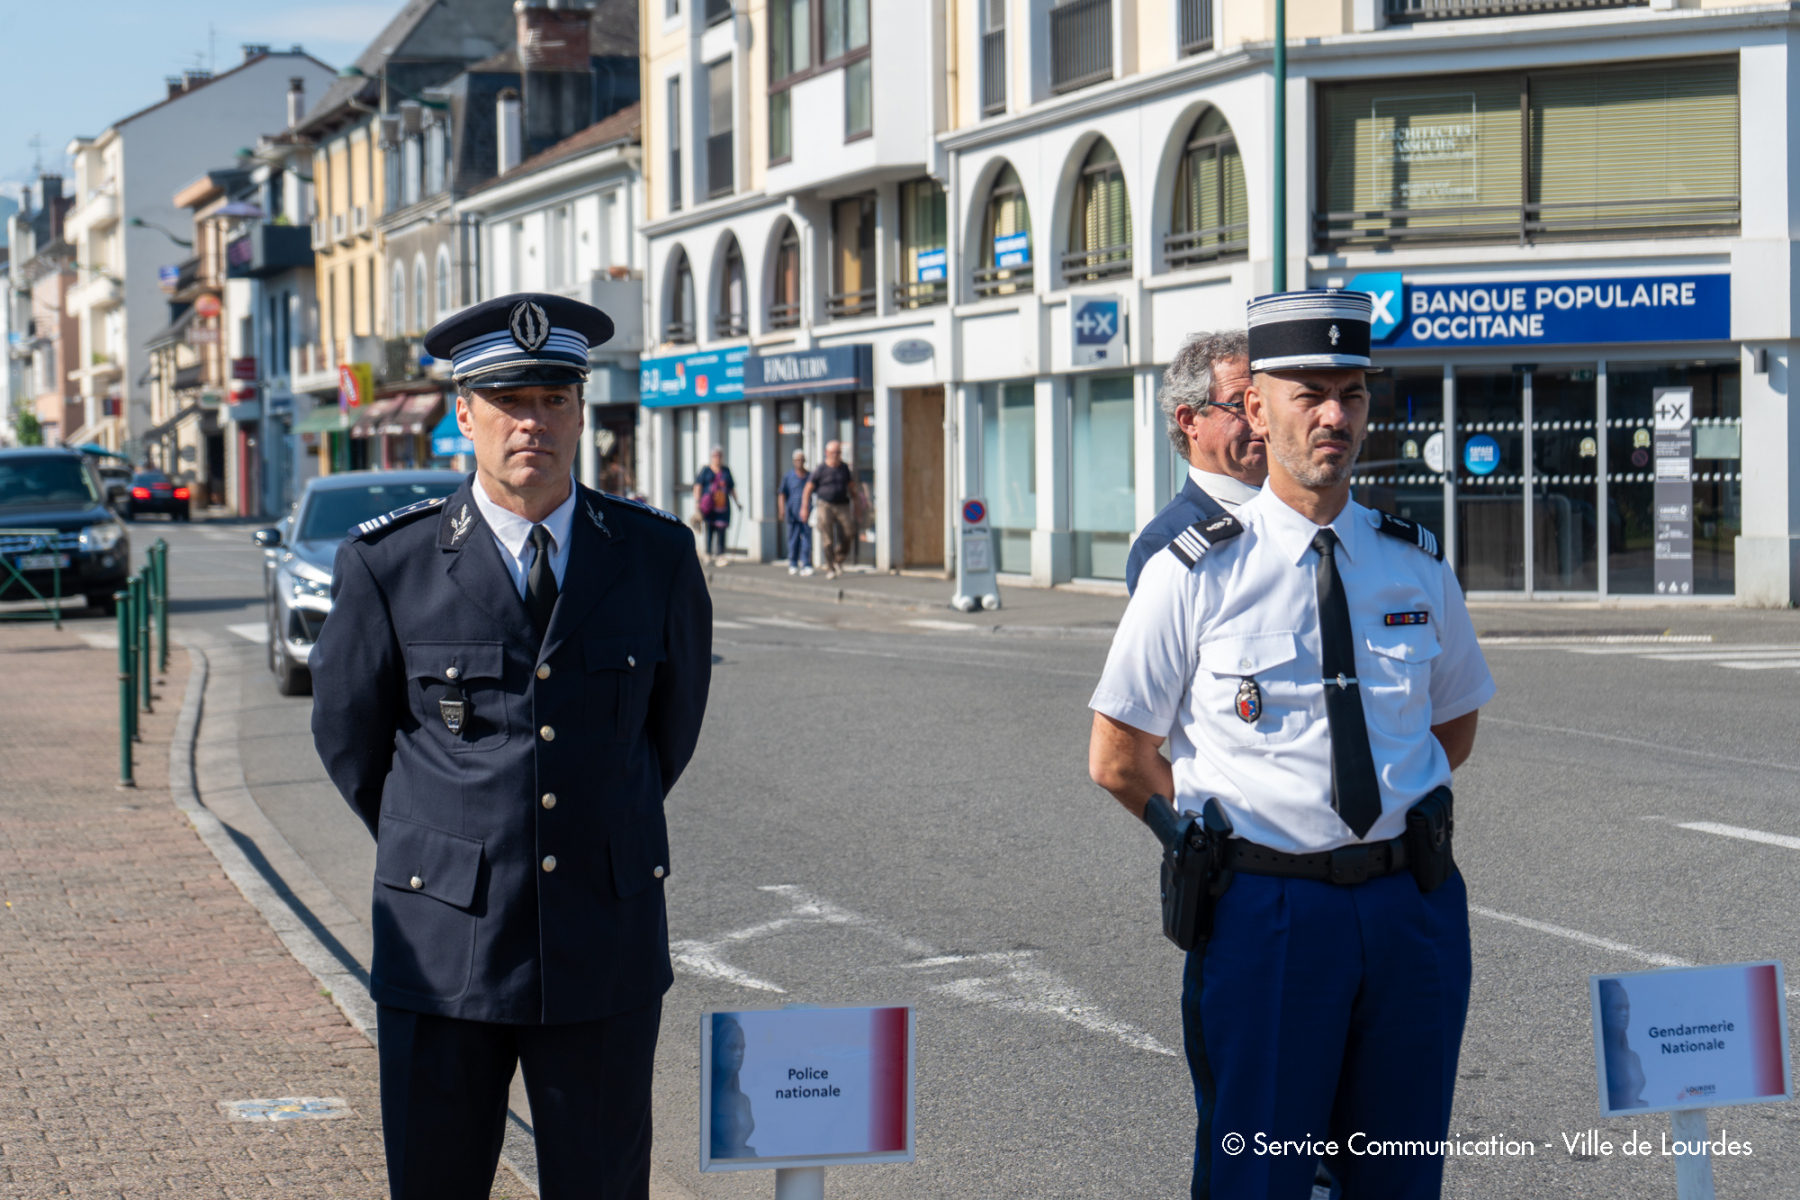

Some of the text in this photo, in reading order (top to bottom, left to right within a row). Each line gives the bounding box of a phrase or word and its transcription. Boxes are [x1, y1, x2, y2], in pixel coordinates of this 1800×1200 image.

[1411, 281, 1697, 314] BANQUE POPULAIRE
[1411, 313, 1545, 340] OCCITANE
[1648, 1019, 1735, 1039] Gendarmerie
[1660, 1038, 1725, 1055] Nationale
[788, 1067, 829, 1081] Police
[775, 1084, 841, 1099] nationale
